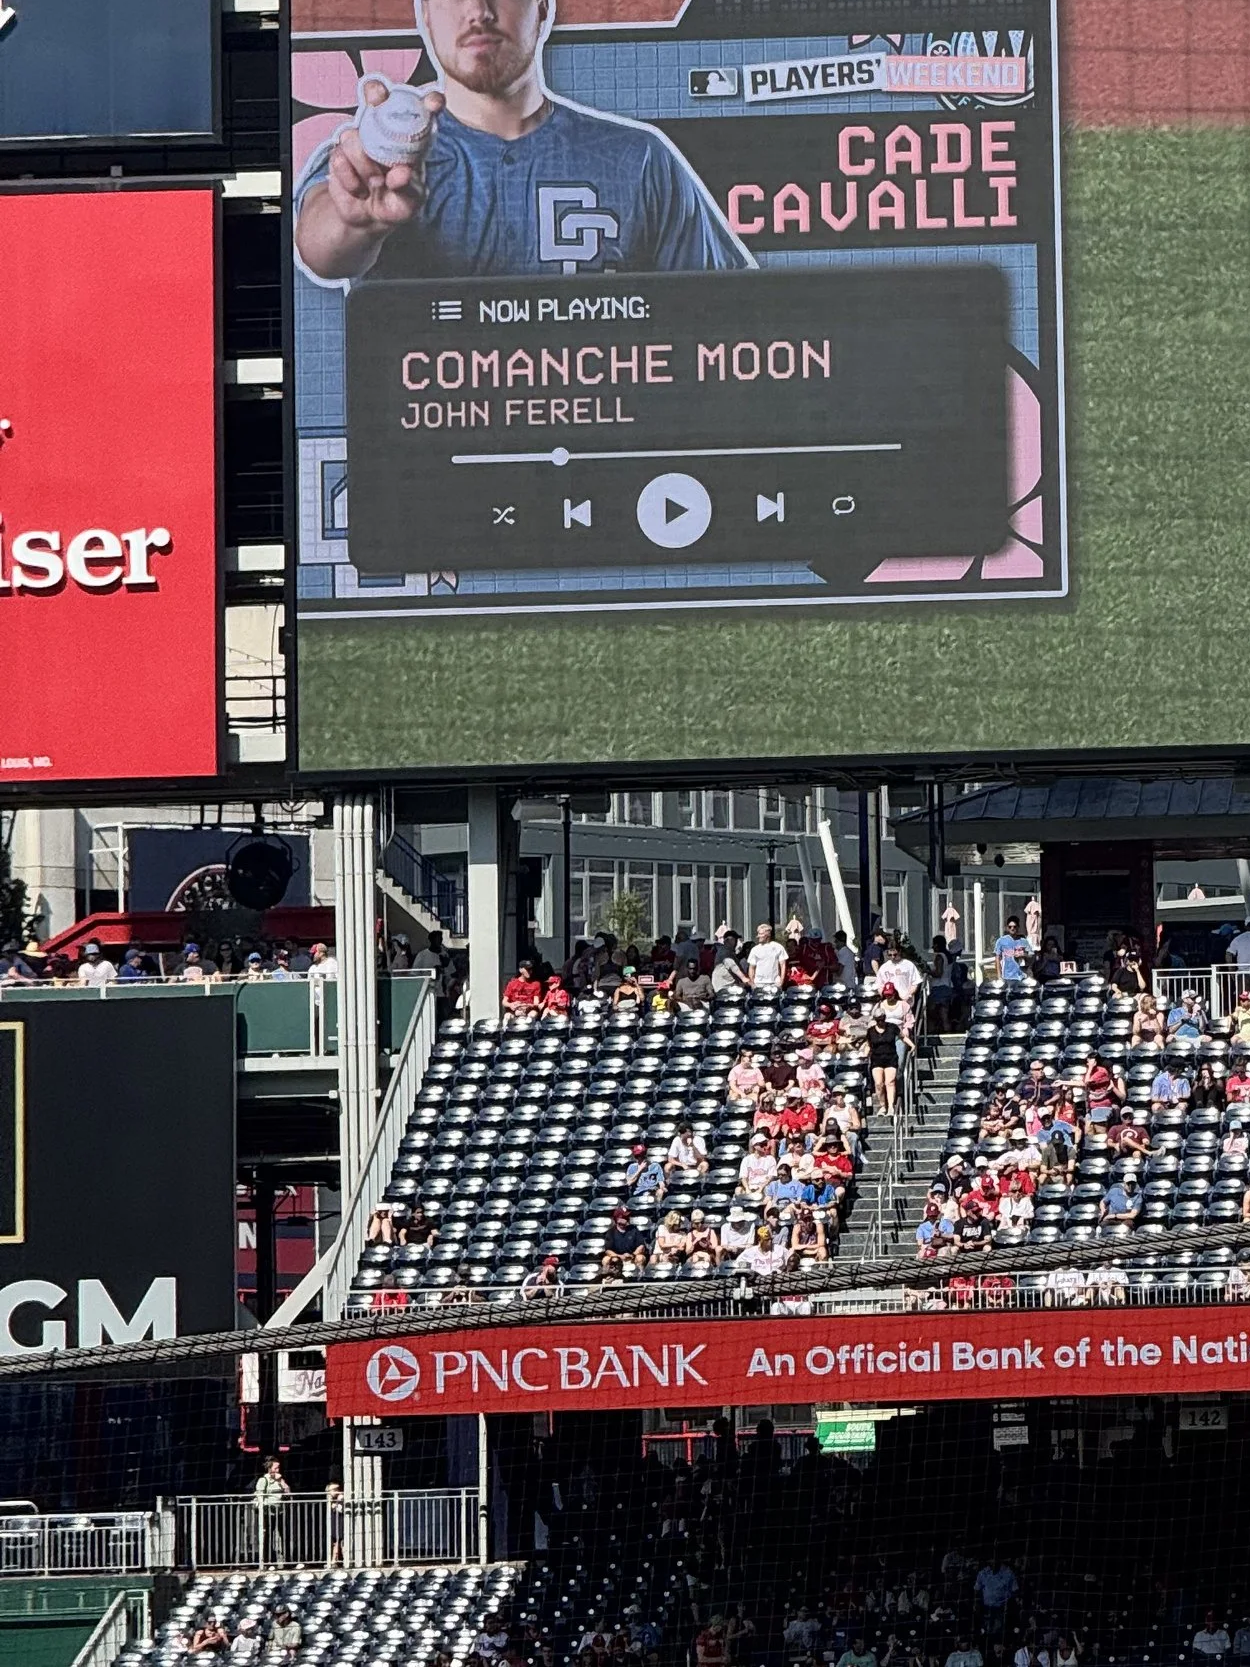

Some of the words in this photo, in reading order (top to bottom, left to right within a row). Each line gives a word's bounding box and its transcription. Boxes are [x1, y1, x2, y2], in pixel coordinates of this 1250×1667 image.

[886, 61, 1019, 87] WEEKEND
[838, 120, 1016, 176] CADE
[727, 176, 1018, 234] CAVALLI
[479, 300, 530, 323] NOW
[538, 296, 650, 322] PLAYING:
[402, 343, 673, 390] COMANCHE
[697, 340, 831, 381] MOON
[400, 400, 490, 429] JOHN
[505, 397, 635, 426] FERELL
[0, 1277, 177, 1355] GM
[747, 1346, 797, 1377] An
[805, 1340, 941, 1375] Official
[952, 1338, 1045, 1372] Bank
[1054, 1337, 1092, 1369] of
[1101, 1336, 1163, 1367] the
[1188, 1410, 1222, 1427] 142
[364, 1432, 397, 1449] 143
